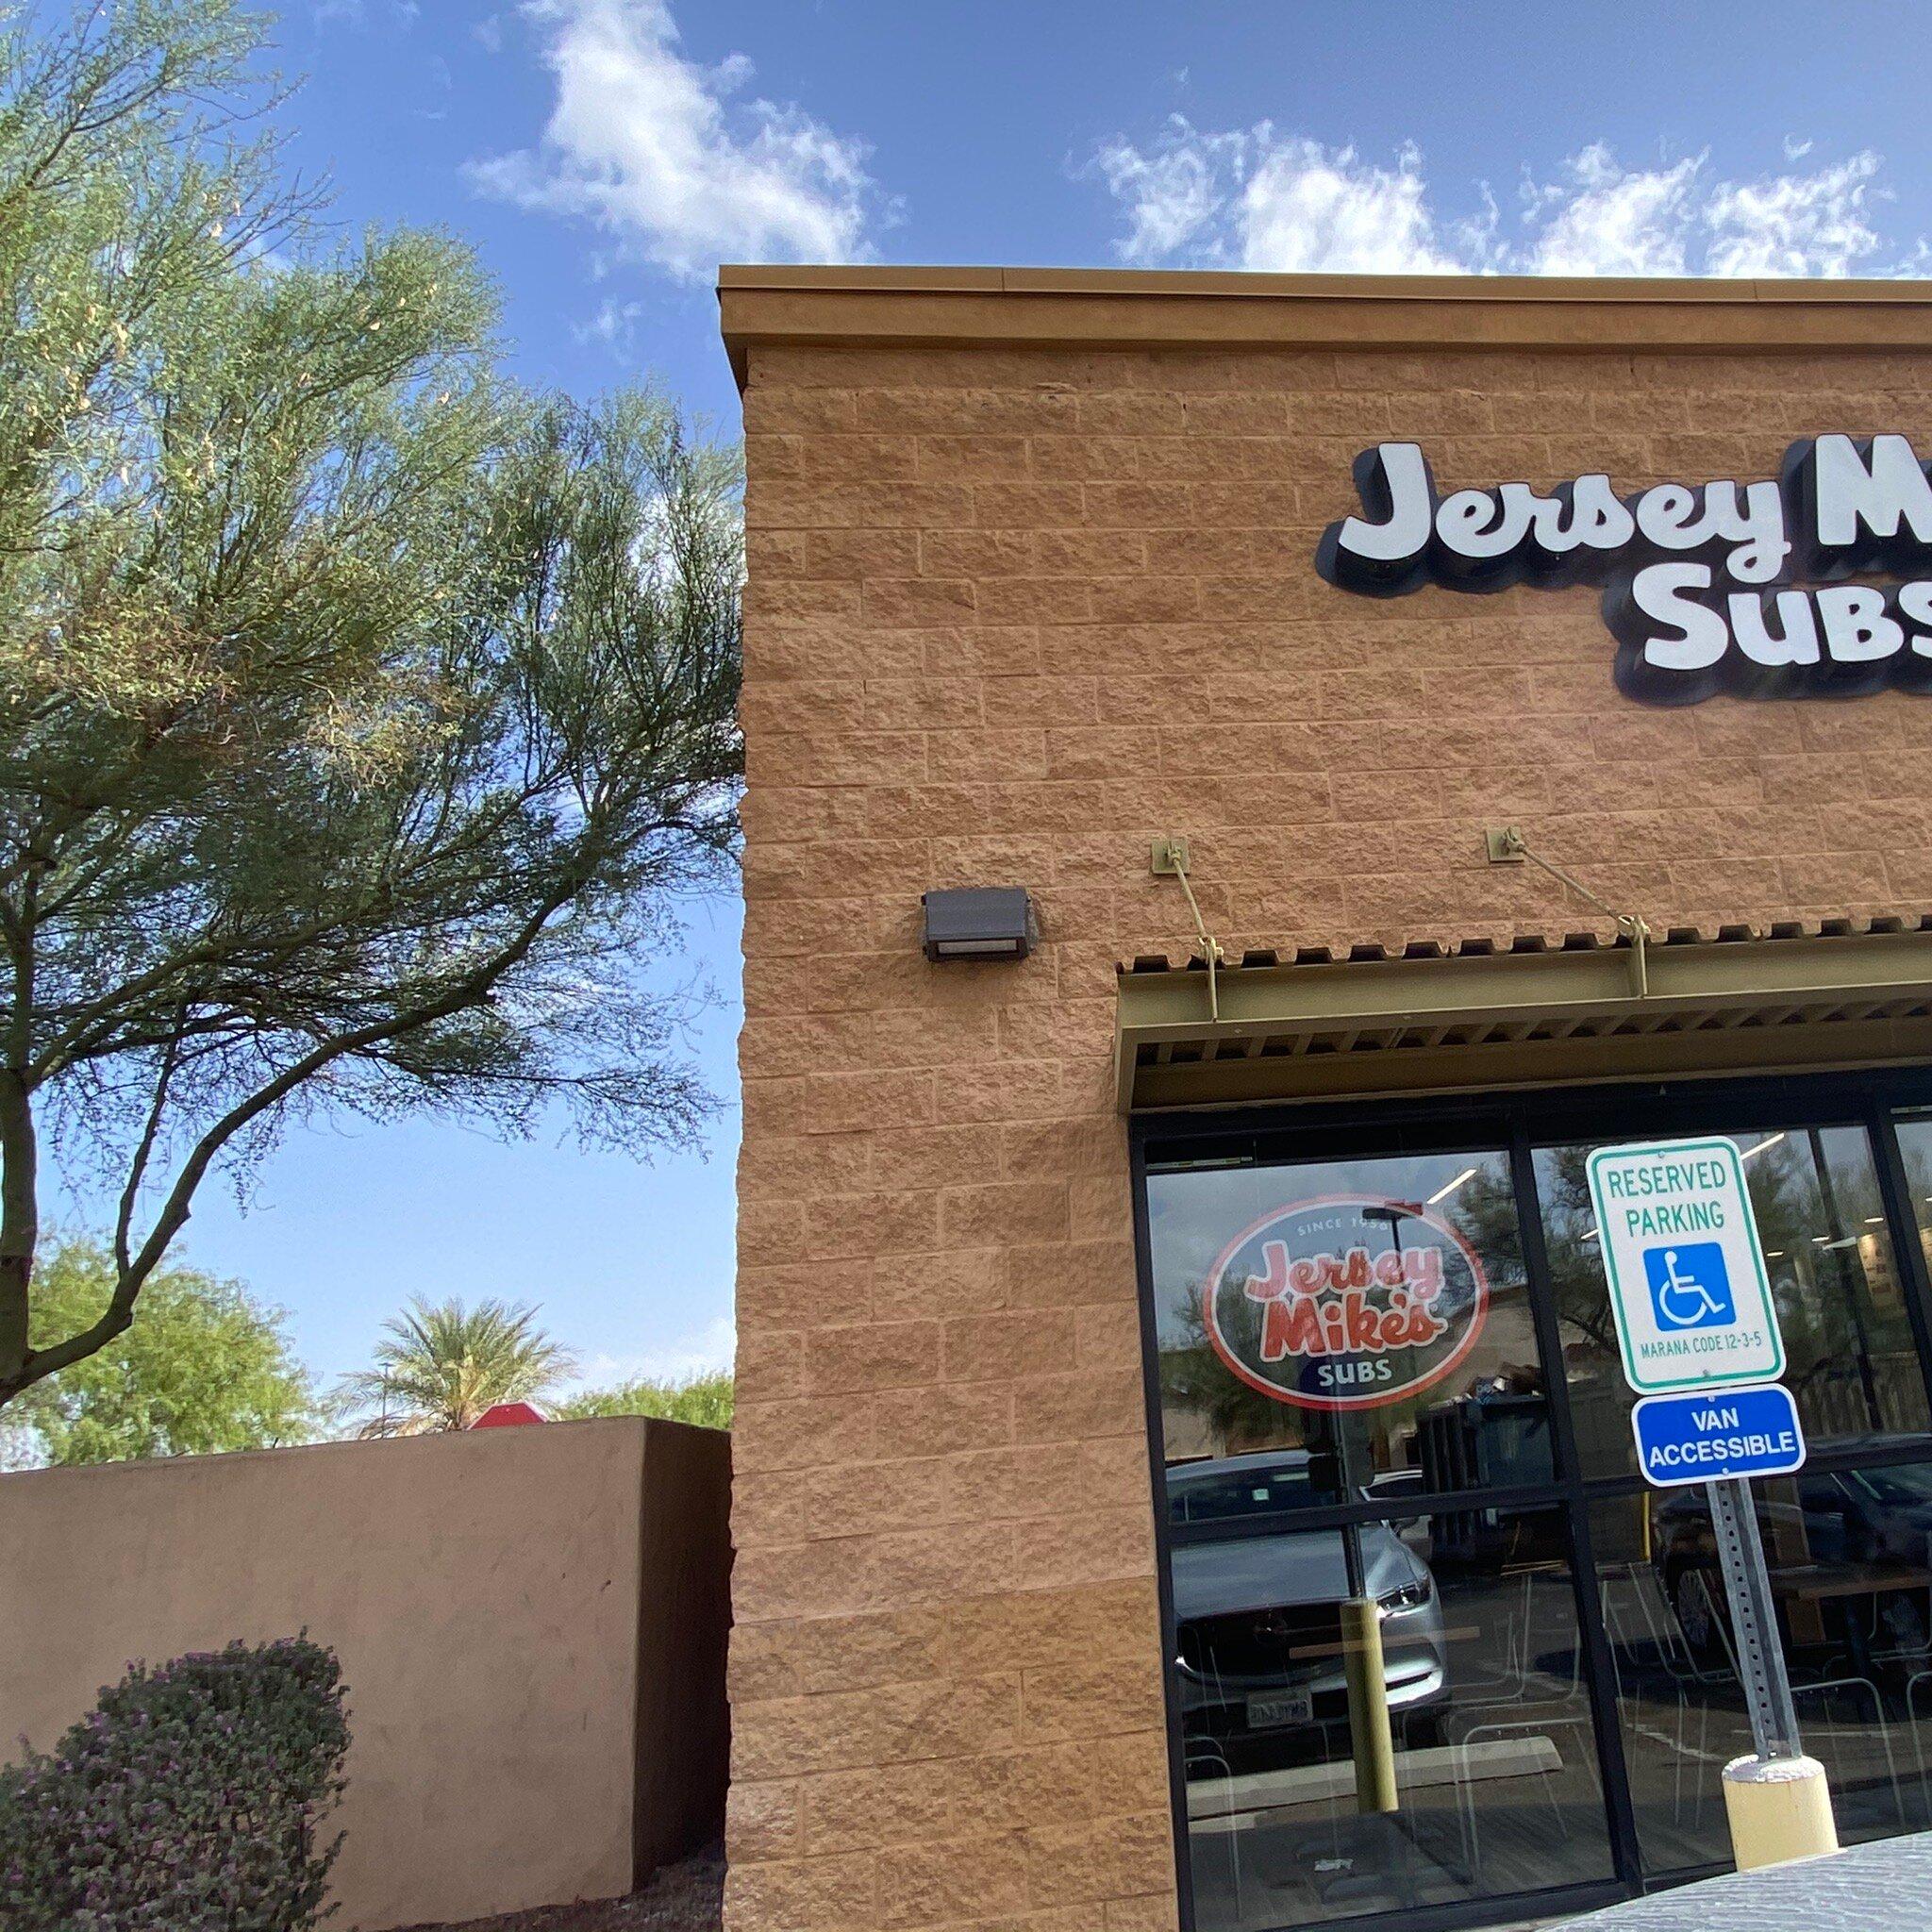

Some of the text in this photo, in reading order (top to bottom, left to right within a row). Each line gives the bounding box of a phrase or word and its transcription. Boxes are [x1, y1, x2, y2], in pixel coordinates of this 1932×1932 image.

[1338, 441, 1792, 584] Jersey
[1607, 1160, 1726, 1198] RESERVED
[1296, 1217, 1342, 1237] SINCE
[1625, 1200, 1724, 1238] PARKING
[1243, 1239, 1446, 1304] Jersey
[1259, 1288, 1449, 1362] Mike's
[1640, 1330, 1762, 1358] MARANA CODE 12-3-5
[1317, 1358, 1393, 1388] SUBS
[1690, 1407, 1740, 1432] VAN
[1649, 1430, 1797, 1468] ACCESSIBLE
